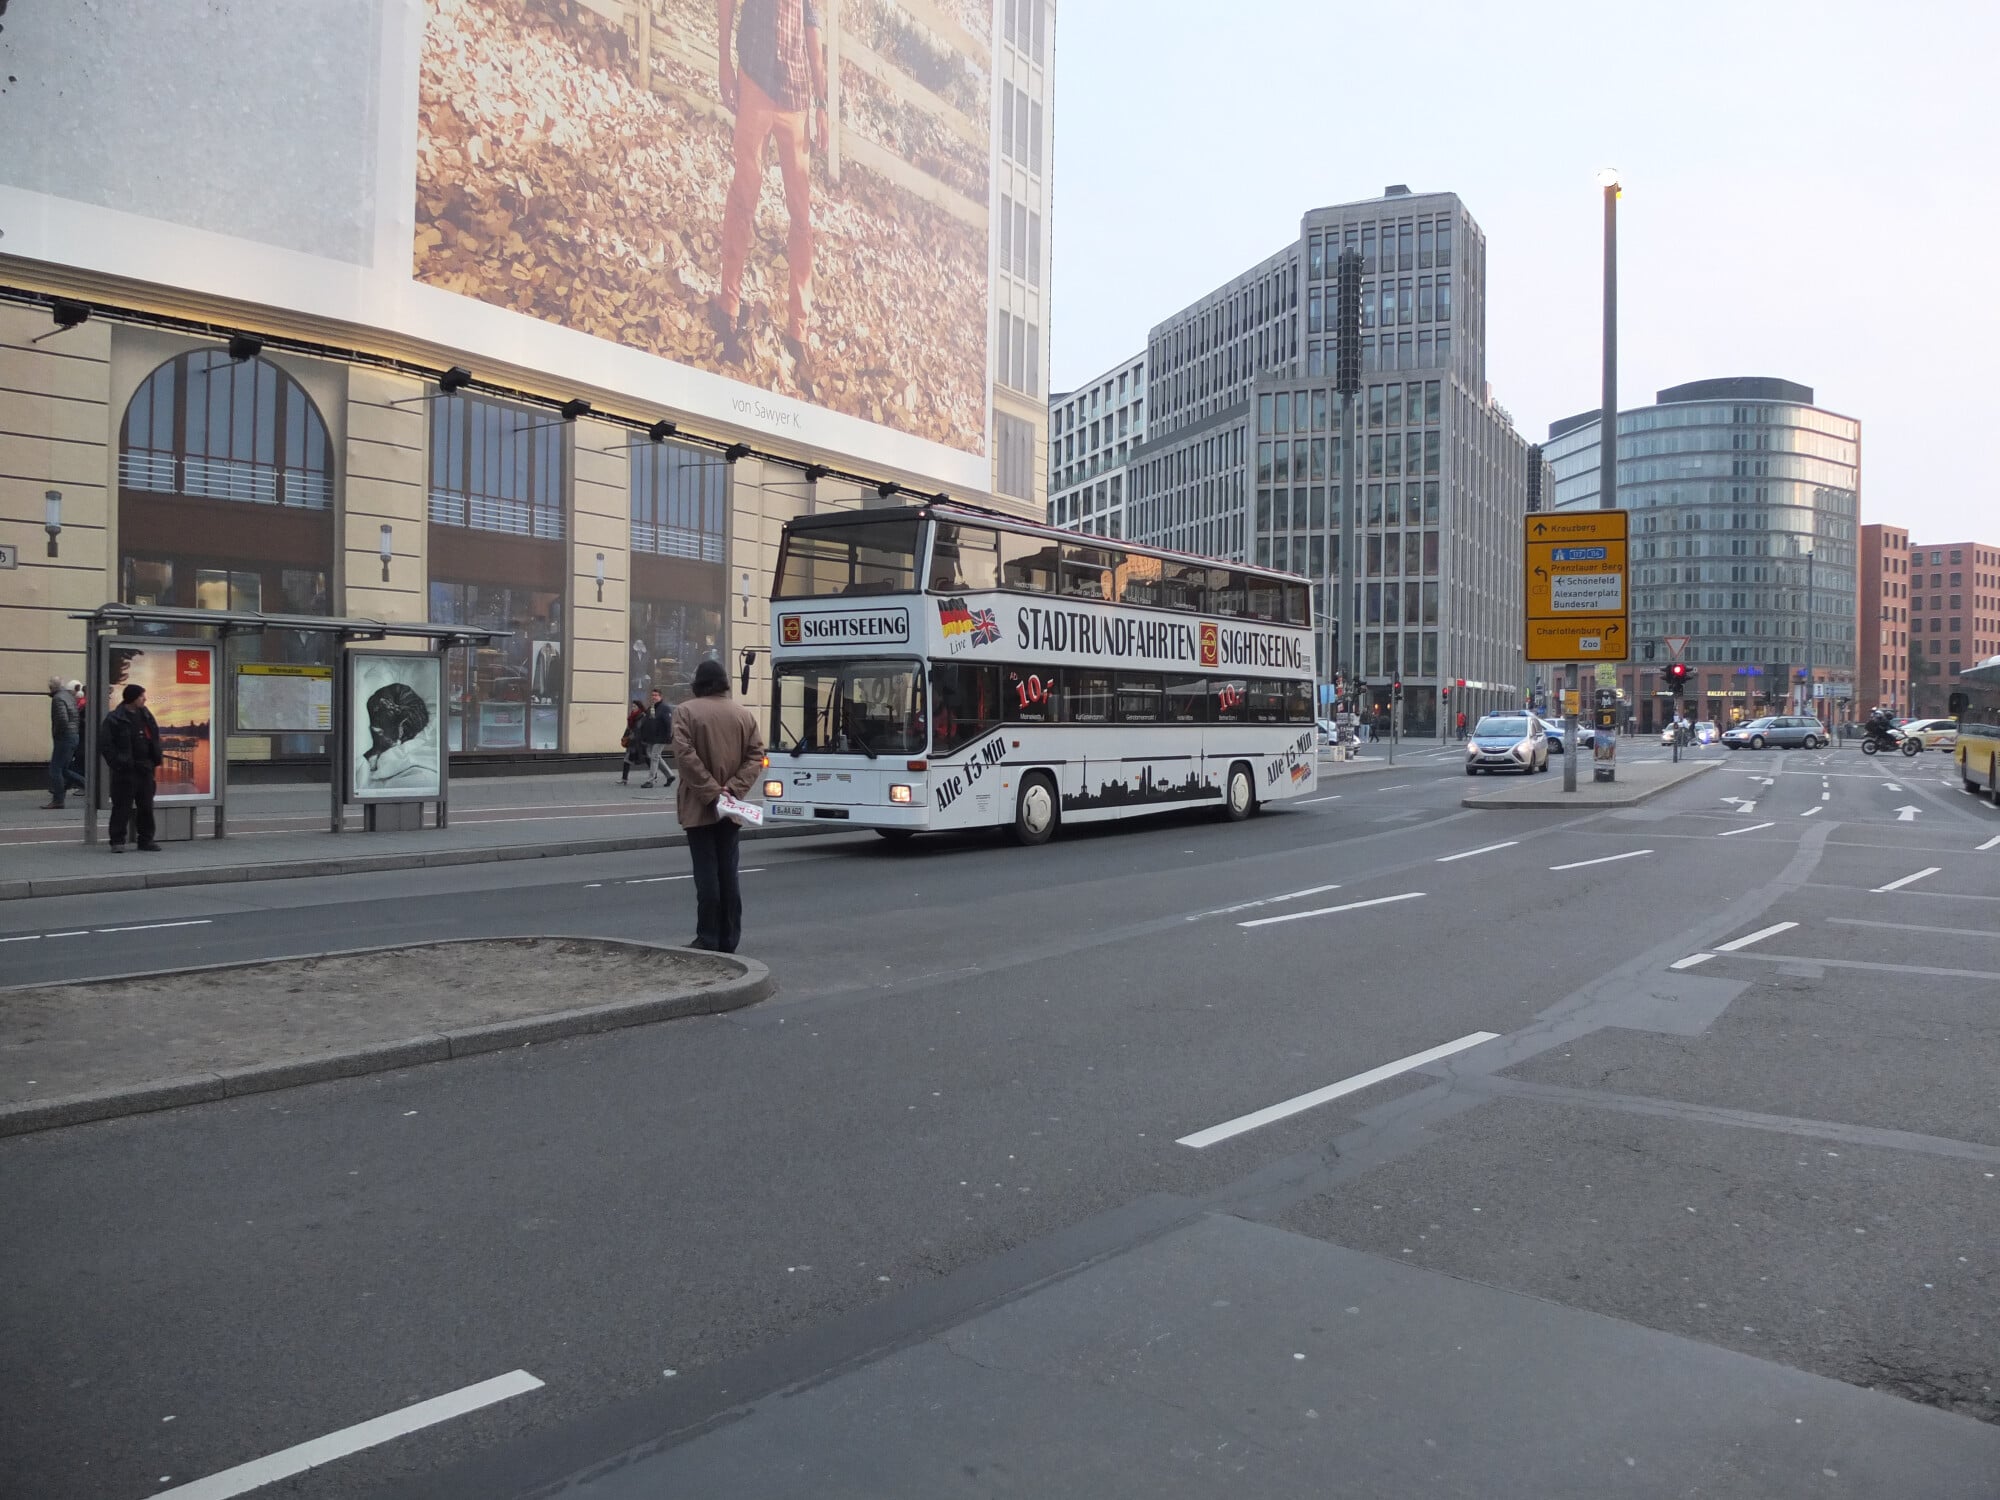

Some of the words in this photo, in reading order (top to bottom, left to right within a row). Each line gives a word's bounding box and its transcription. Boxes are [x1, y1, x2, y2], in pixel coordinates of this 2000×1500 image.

[732, 398, 752, 413] von
[754, 401, 790, 425] Sawyer
[1551, 524, 1596, 533] Kreuzberg
[1551, 564, 1598, 572] Prenzlauer
[1602, 563, 1623, 572] Berg
[1567, 575, 1615, 585] Schönefeld
[1554, 589, 1619, 598] Alexanderplatz
[1554, 600, 1598, 609] Bundesrat
[804, 617, 906, 638] SIGHTSEEING
[1018, 606, 1196, 661] STADTRUNDFAHRTEN
[1536, 626, 1602, 636] Charlottenburg
[950, 638, 966, 656] Live
[1220, 629, 1301, 669] SIGHTSEEING
[1582, 639, 1599, 648] Zoo
[935, 775, 963, 813] Alle
[963, 753, 982, 787] 15
[981, 737, 1007, 770] Min
[1267, 758, 1284, 787] Alle
